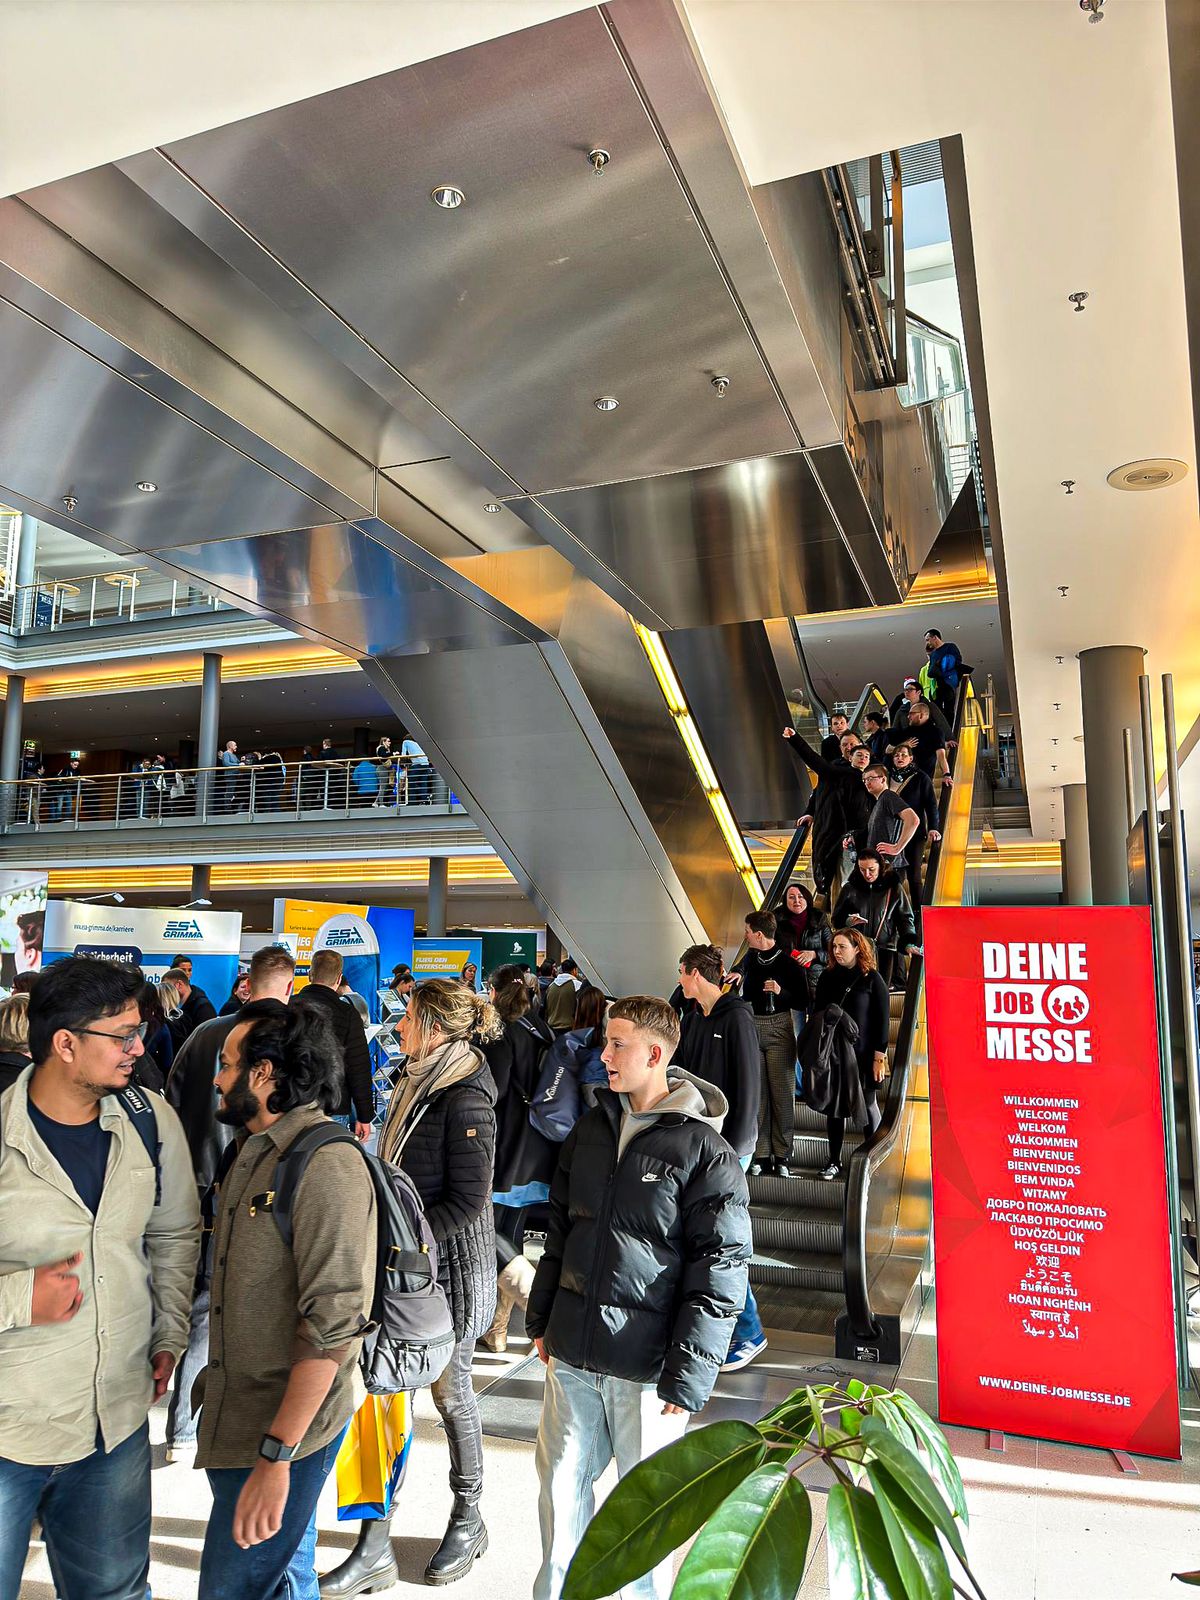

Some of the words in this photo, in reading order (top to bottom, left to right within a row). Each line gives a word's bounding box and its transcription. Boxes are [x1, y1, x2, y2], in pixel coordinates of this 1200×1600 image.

[163, 930, 204, 939] GRIMMA
[325, 938, 365, 946] GRIMMA
[982, 941, 1089, 981] DEINE
[993, 991, 1034, 1015] JOB
[986, 1026, 1093, 1064] MESSE
[1003, 1095, 1079, 1109] WILLKOMMEN
[1014, 1108, 1069, 1121] WELCOME
[1017, 1122, 1067, 1135] WELKOM
[1007, 1133, 1078, 1149] VÄLKOMMEN
[1012, 1147, 1075, 1162] BIENVENUE
[1007, 1160, 1081, 1175] BIENVENIDOS
[1014, 1174, 1038, 1185] BEM
[1039, 1175, 1075, 1188] VINDA
[1022, 1187, 1068, 1201] WITAMY
[986, 1197, 1025, 1211] ДОБРО
[1026, 1201, 1107, 1218] ПОЖАЛОВАТЬ
[990, 1211, 1043, 1225] ЛАСКАВО
[1044, 1216, 1104, 1231] ПРОСИМО
[1009, 1224, 1085, 1243] ÜDVÖZÖLJÜK
[1014, 1240, 1038, 1254] HOŞ
[1039, 1242, 1081, 1256] GELDIN
[1035, 1254, 1061, 1269] 欢迎
[1025, 1267, 1072, 1283] ようこそ
[1019, 1279, 1078, 1297] ยินดีต้อนรับ
[1008, 1293, 1042, 1307] HOAN
[1043, 1297, 1092, 1313] NGHÊNH
[1029, 1309, 1062, 1323] स्वागत
[979, 1374, 1132, 1408] WWW.DEINE-JOBMESSE.DE
